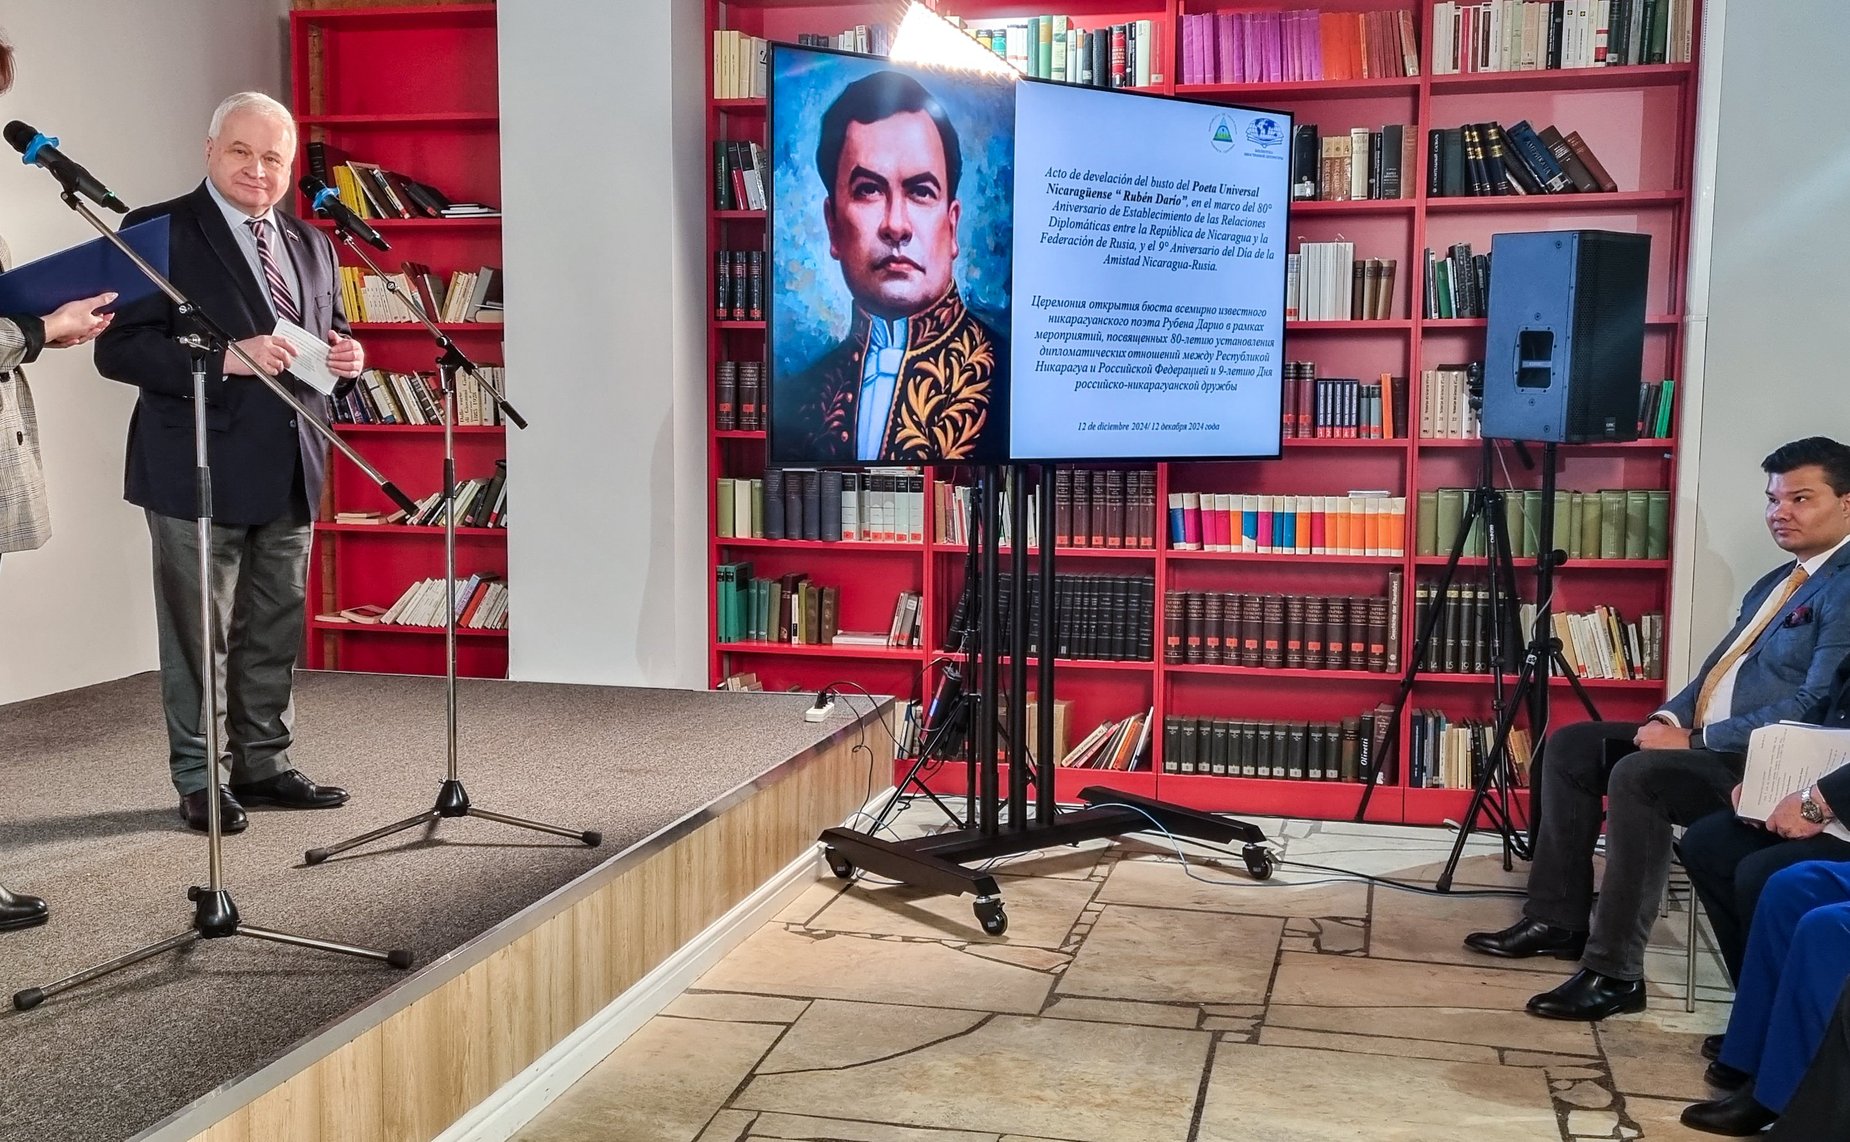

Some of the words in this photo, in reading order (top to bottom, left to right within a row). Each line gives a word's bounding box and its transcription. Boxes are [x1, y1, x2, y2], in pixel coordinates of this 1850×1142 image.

[1044, 167, 1068, 180] Acto
[1069, 169, 1082, 181] de
[1082, 171, 1133, 186] develación
[1134, 175, 1149, 187] del
[1150, 176, 1175, 190] busto
[1176, 179, 1190, 191] del
[1192, 180, 1217, 194] Poeta
[1219, 183, 1260, 198] Universal
[1046, 183, 1112, 202] Nicaragüense
[1123, 190, 1153, 204] Rubén
[1191, 199, 1202, 208] en
[1203, 197, 1212, 209] el
[1213, 201, 1241, 212] marco
[1242, 201, 1256, 213] del
[1051, 200, 1107, 215] Aniversario
[1109, 204, 1121, 217] de
[1122, 205, 1193, 223] Establecimiento
[1194, 212, 1205, 224] de
[1207, 212, 1220, 225] las
[1221, 214, 1266, 229] Relaciones
[1048, 216, 1111, 234] Diplomáticas
[1112, 222, 1136, 234] entre
[1138, 223, 1148, 235] la
[1148, 224, 1194, 241] República
[1194, 227, 1206, 240] de
[1207, 228, 1251, 245] Nicaragua
[1252, 235, 1259, 246] y
[1259, 232, 1269, 244] la
[1040, 232, 1094, 247] Federación
[1096, 236, 1108, 248] de
[1108, 237, 1138, 253] Rusia,
[1139, 242, 1147, 254] y
[1147, 240, 1156, 252] el
[1169, 242, 1220, 256] Aniversario
[1221, 245, 1235, 257] del
[1236, 246, 1253, 258] Día
[1254, 247, 1265, 259] de
[1266, 248, 1275, 260] la
[1103, 253, 1141, 266] Amistad
[1141, 255, 1217, 272] Nicaragua-Rusia.
[1031, 295, 1087, 312] Церемония
[1088, 301, 1140, 314] открытия
[1141, 300, 1173, 313] бюста
[1174, 305, 1217, 317] всемирно
[1218, 307, 1267, 317] известного
[1048, 315, 1129, 330] никарагуанского
[1130, 318, 1161, 328] поэта
[1162, 316, 1194, 332] Рубена
[1195, 318, 1224, 333] Дарио
[1225, 322, 1231, 331] в
[1232, 323, 1265, 334] рамках
[1034, 329, 1104, 344] мероприятий,
[1106, 333, 1169, 346] посвященных
[1170, 333, 1214, 345] 80-летию
[1215, 337, 1275, 349] установления
[1039, 345, 1127, 361] дипломатических
[1127, 348, 1181, 360] отношений
[1181, 352, 1214, 364] между
[1215, 349, 1270, 364] Республикой
[1034, 361, 1088, 376] Никарагуа
[1089, 365, 1096, 373] и
[1097, 362, 1153, 375] Российской
[1154, 363, 1209, 378] Федерацией
[1210, 367, 1217, 376] и
[1217, 364, 1255, 376] 9-летию
[1256, 366, 1273, 378] Дня
[1074, 378, 1200, 393] российско-никарагуанской
[1200, 380, 1238, 394] дружбы
[1078, 422, 1087, 431] 12
[1087, 421, 1096, 431] de
[1097, 421, 1130, 431] diciembre
[1151, 422, 1160, 431] 12
[1160, 422, 1188, 432] декабря
[1188, 422, 1204, 431] 2024
[1204, 423, 1220, 431] года
[1360, 737, 1369, 766] Olivetti
